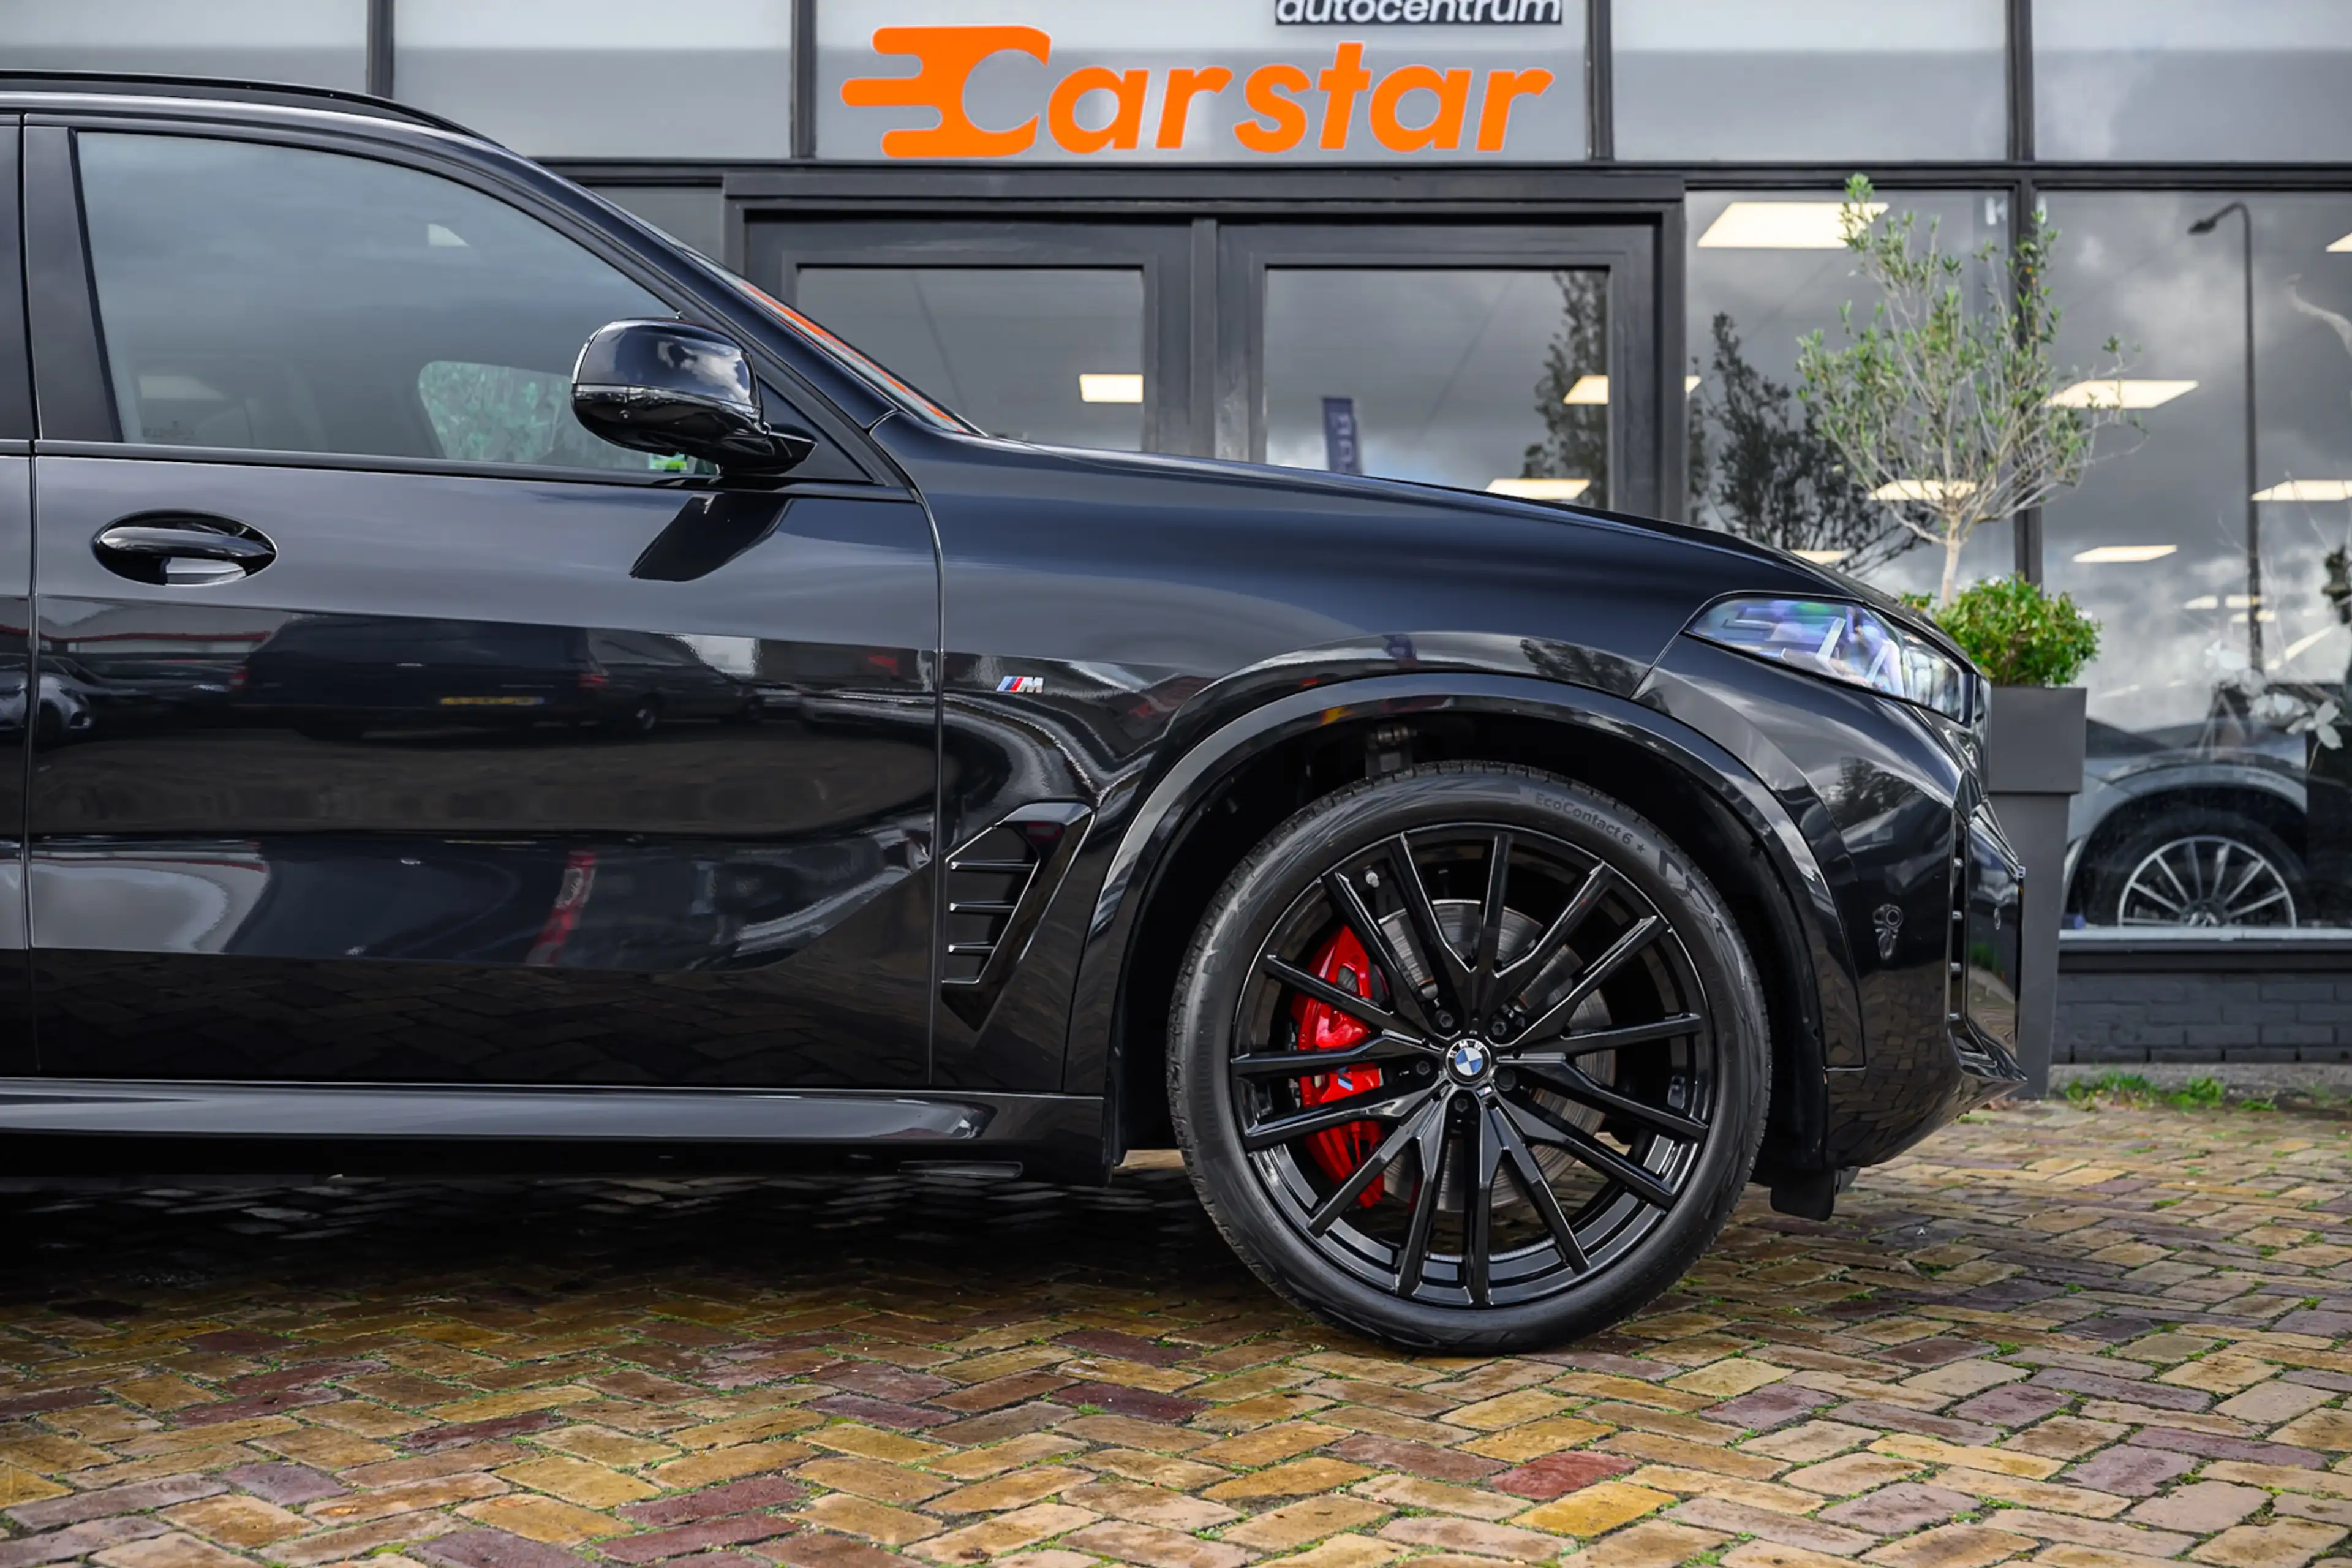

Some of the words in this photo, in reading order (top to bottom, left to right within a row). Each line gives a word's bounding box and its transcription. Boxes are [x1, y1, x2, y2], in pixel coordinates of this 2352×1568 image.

[1276, 0, 1561, 23] autocentrum
[840, 24, 1554, 158] Carstar
[1535, 792, 1621, 839] EcoContact
[1621, 832, 1634, 845] 6
[1447, 1039, 1484, 1059] BMW
